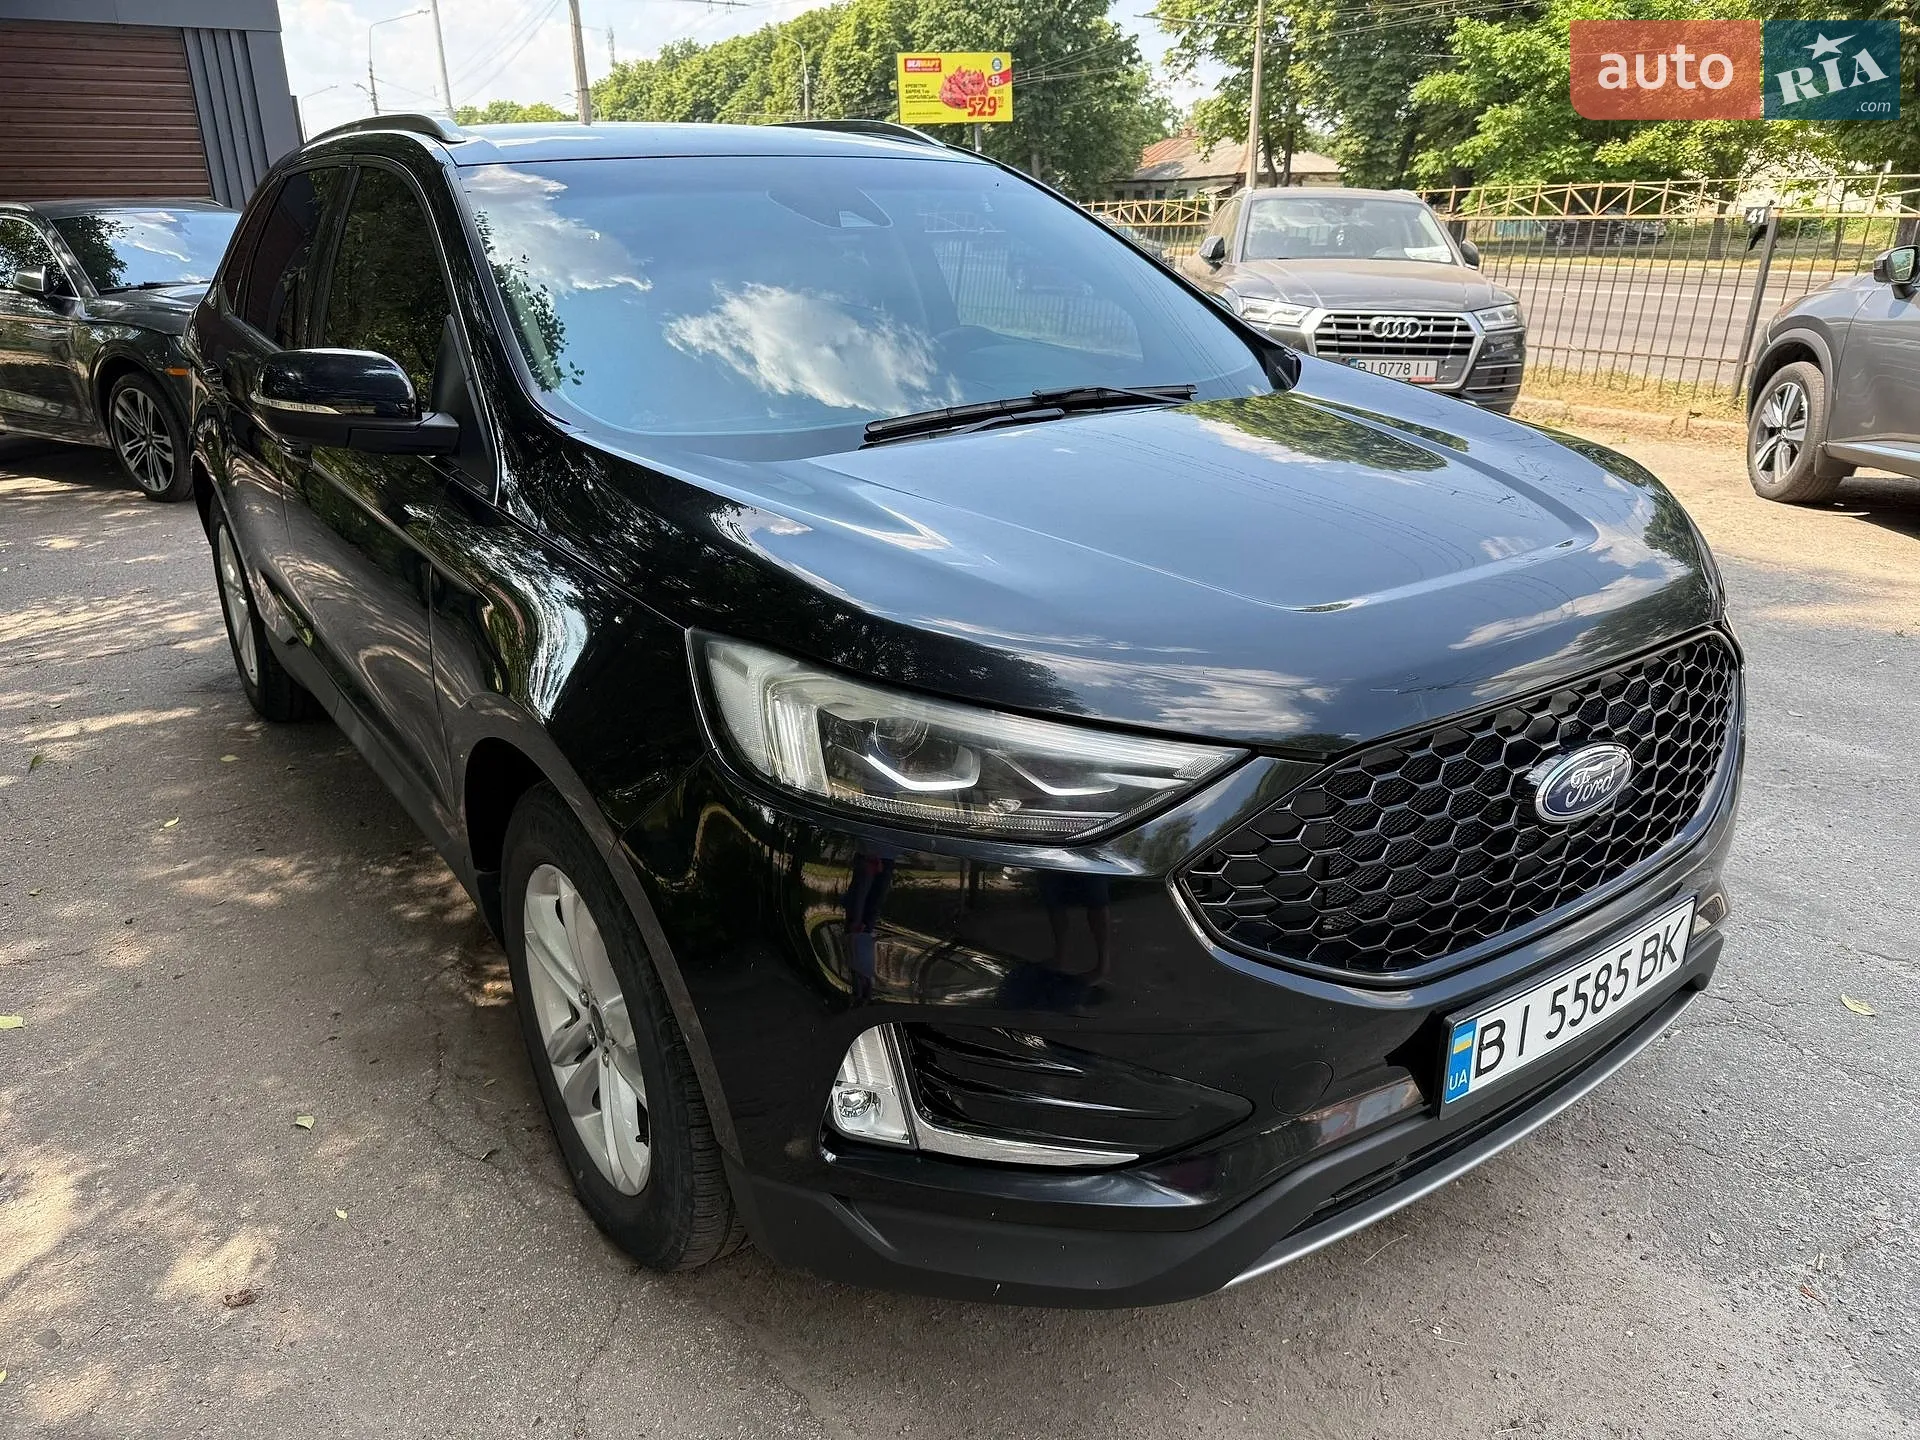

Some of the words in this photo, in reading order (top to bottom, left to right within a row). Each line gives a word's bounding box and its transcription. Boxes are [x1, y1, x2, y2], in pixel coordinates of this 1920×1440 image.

[968, 96, 997, 117] 529
[1747, 208, 1766, 224] 41
[1379, 362, 1411, 375] 0778
[1565, 762, 1616, 809] Ford
[1474, 1005, 1530, 1079] BI
[1545, 949, 1633, 1040] 5585
[1636, 914, 1687, 990] BK
[1449, 1069, 1468, 1091] UA
